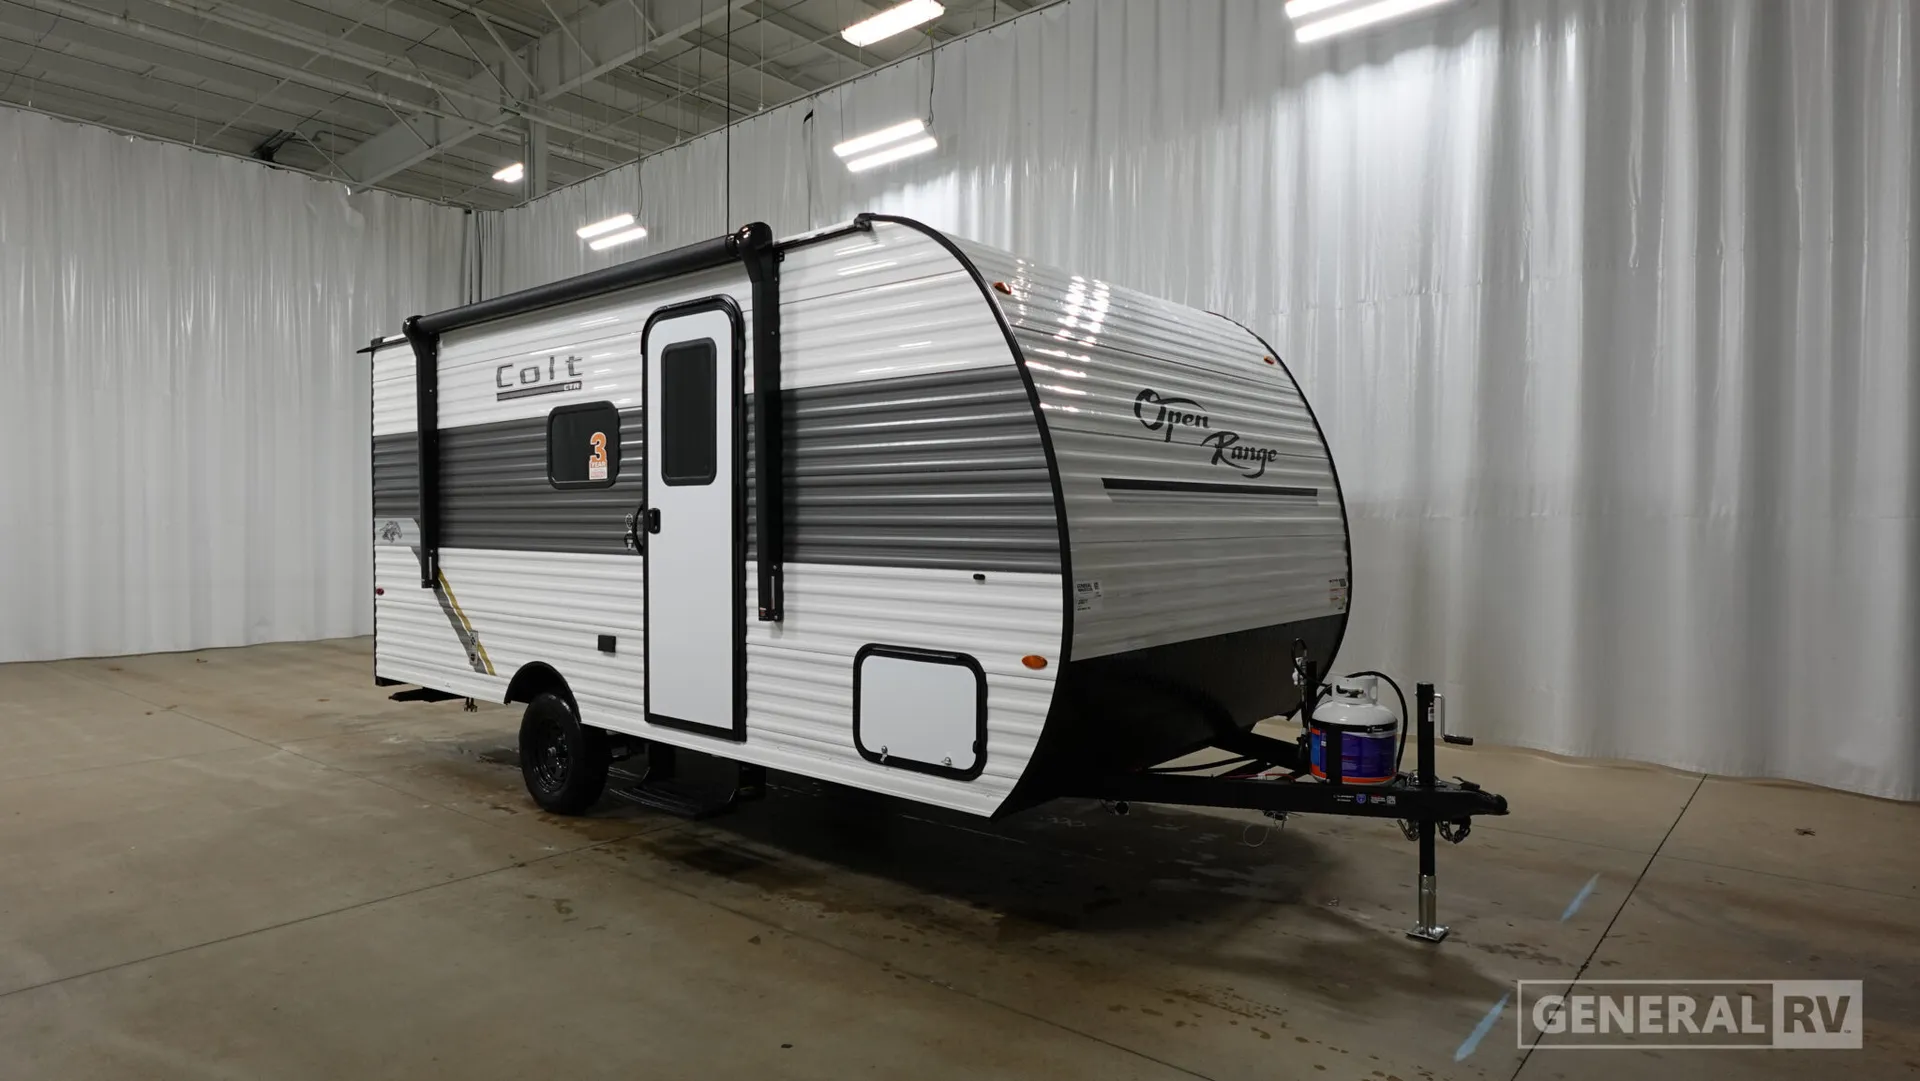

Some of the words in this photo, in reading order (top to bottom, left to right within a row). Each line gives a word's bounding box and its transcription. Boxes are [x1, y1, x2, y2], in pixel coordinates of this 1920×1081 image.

[496, 355, 583, 388] Colt
[1134, 388, 1208, 442] Open
[590, 432, 607, 461] 3
[1200, 431, 1278, 479] Range
